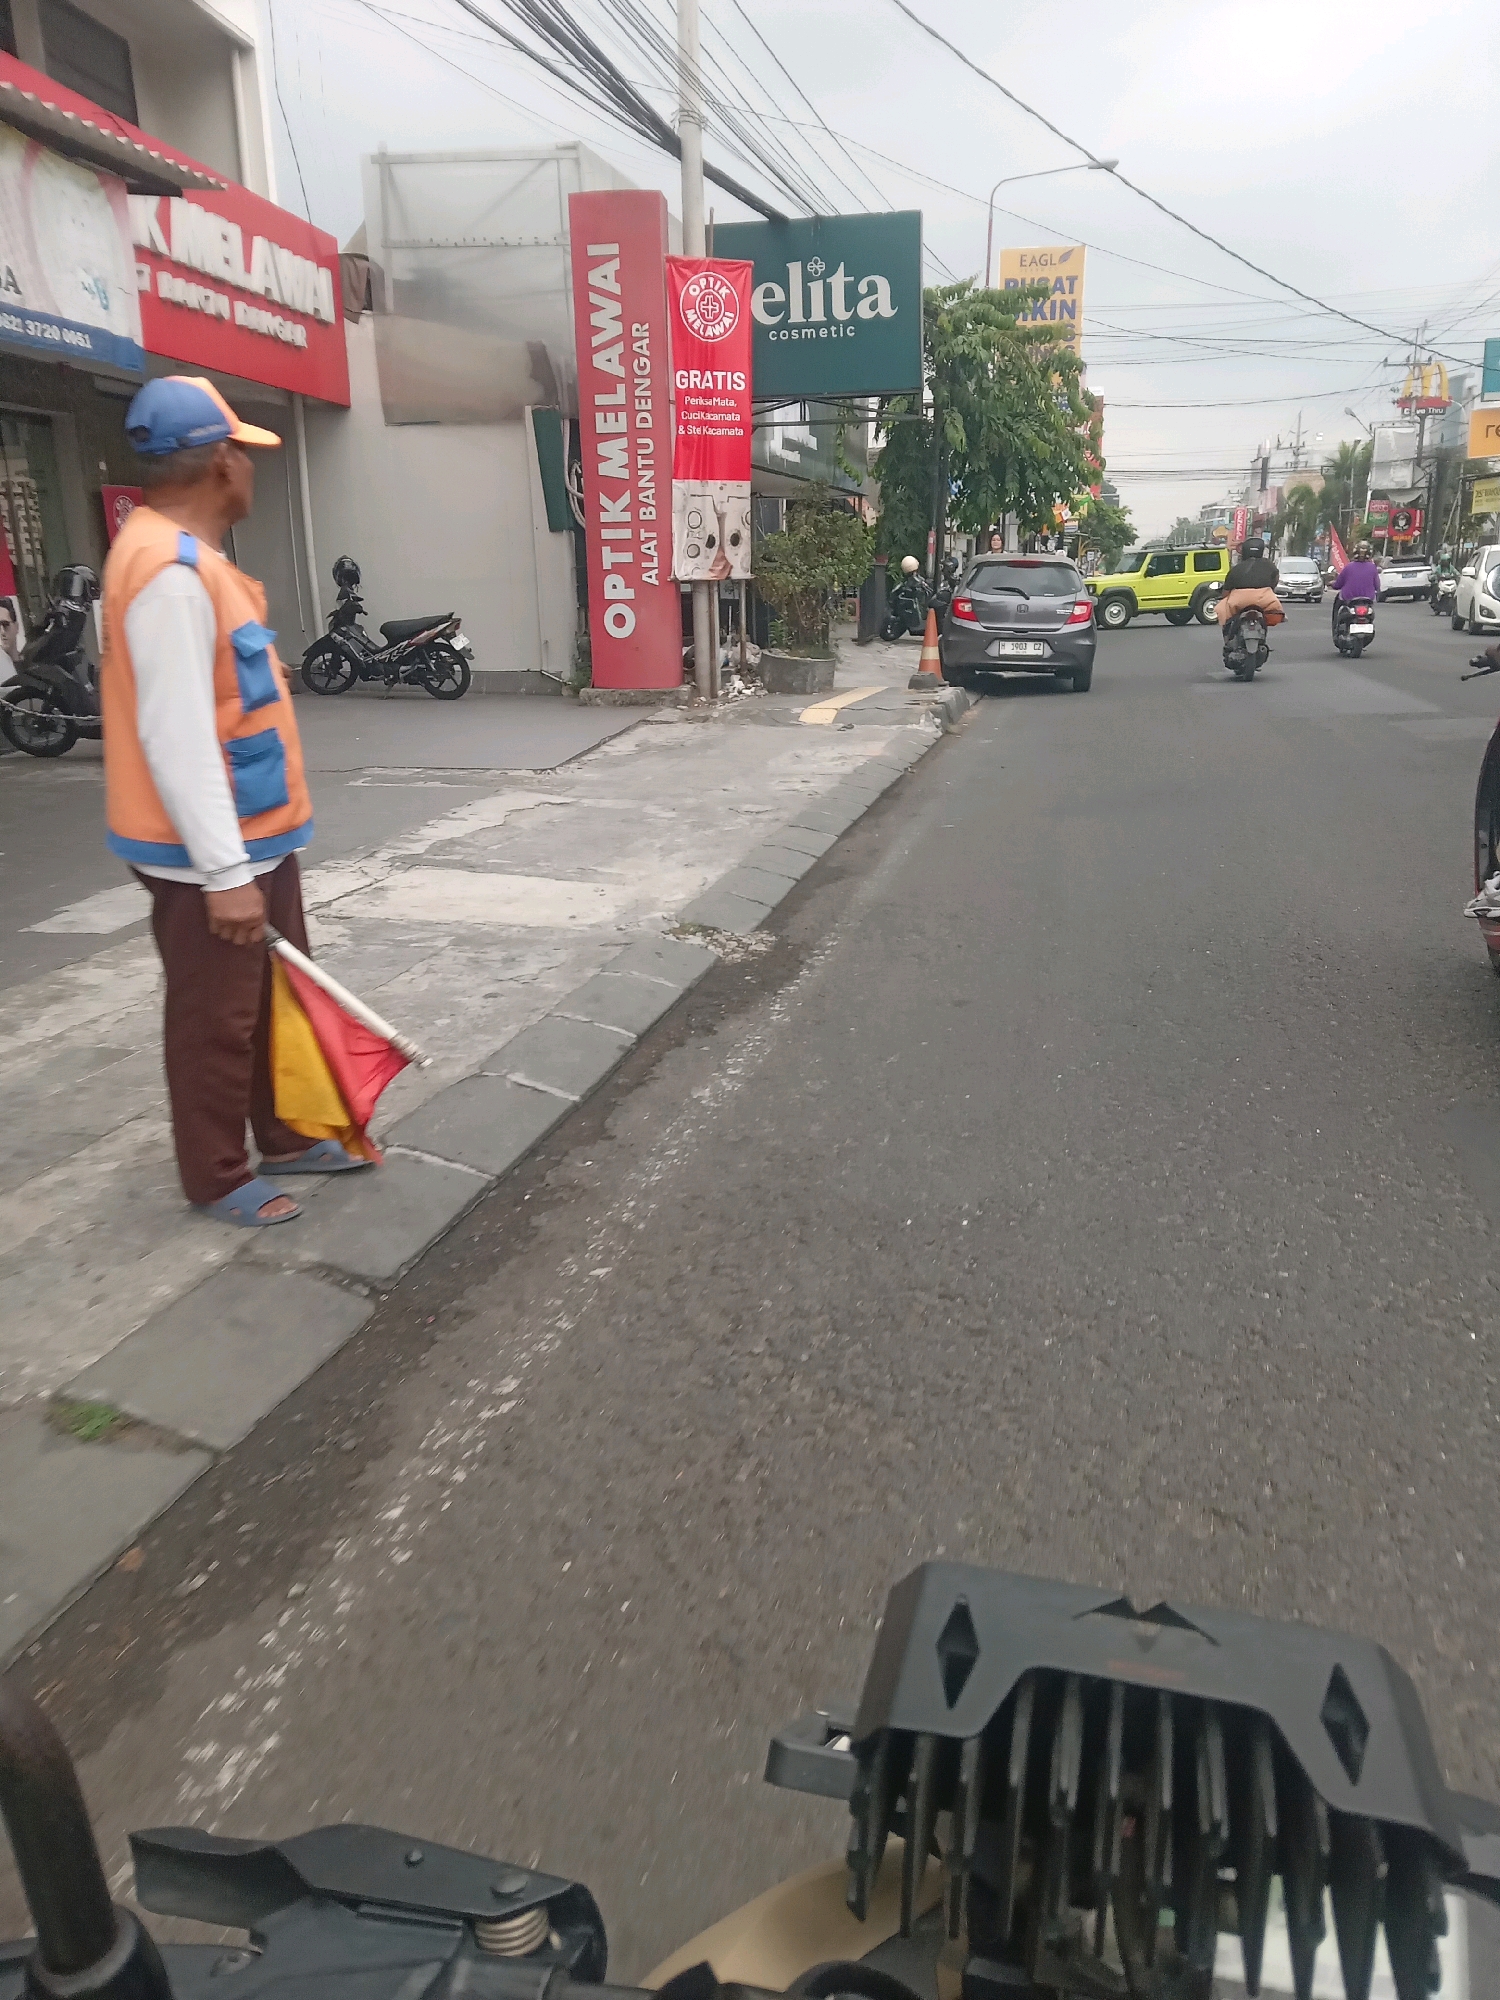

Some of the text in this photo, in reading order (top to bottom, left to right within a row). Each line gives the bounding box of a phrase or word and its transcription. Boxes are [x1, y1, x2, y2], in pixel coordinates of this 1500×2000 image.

[170, 196, 336, 325] MELAWAI
[688, 276, 731, 300] OPTIK
[751, 256, 898, 325] elita
[1014, 299, 1077, 322] KIN
[25, 319, 61, 341] 3720
[233, 300, 309, 349] DENGAR
[684, 308, 735, 338] MELAWAI
[768, 323, 856, 341] cosmetic
[675, 369, 746, 391] GRATIS
[713, 397, 738, 408] Mata,
[681, 410, 741, 422] Cuci Kacamata
[586, 242, 637, 639] OPTIK MELAWAI
[678, 425, 685, 435] &
[703, 426, 744, 436] Kacamata
[631, 322, 660, 586] ALAT BANTU DENGAR
